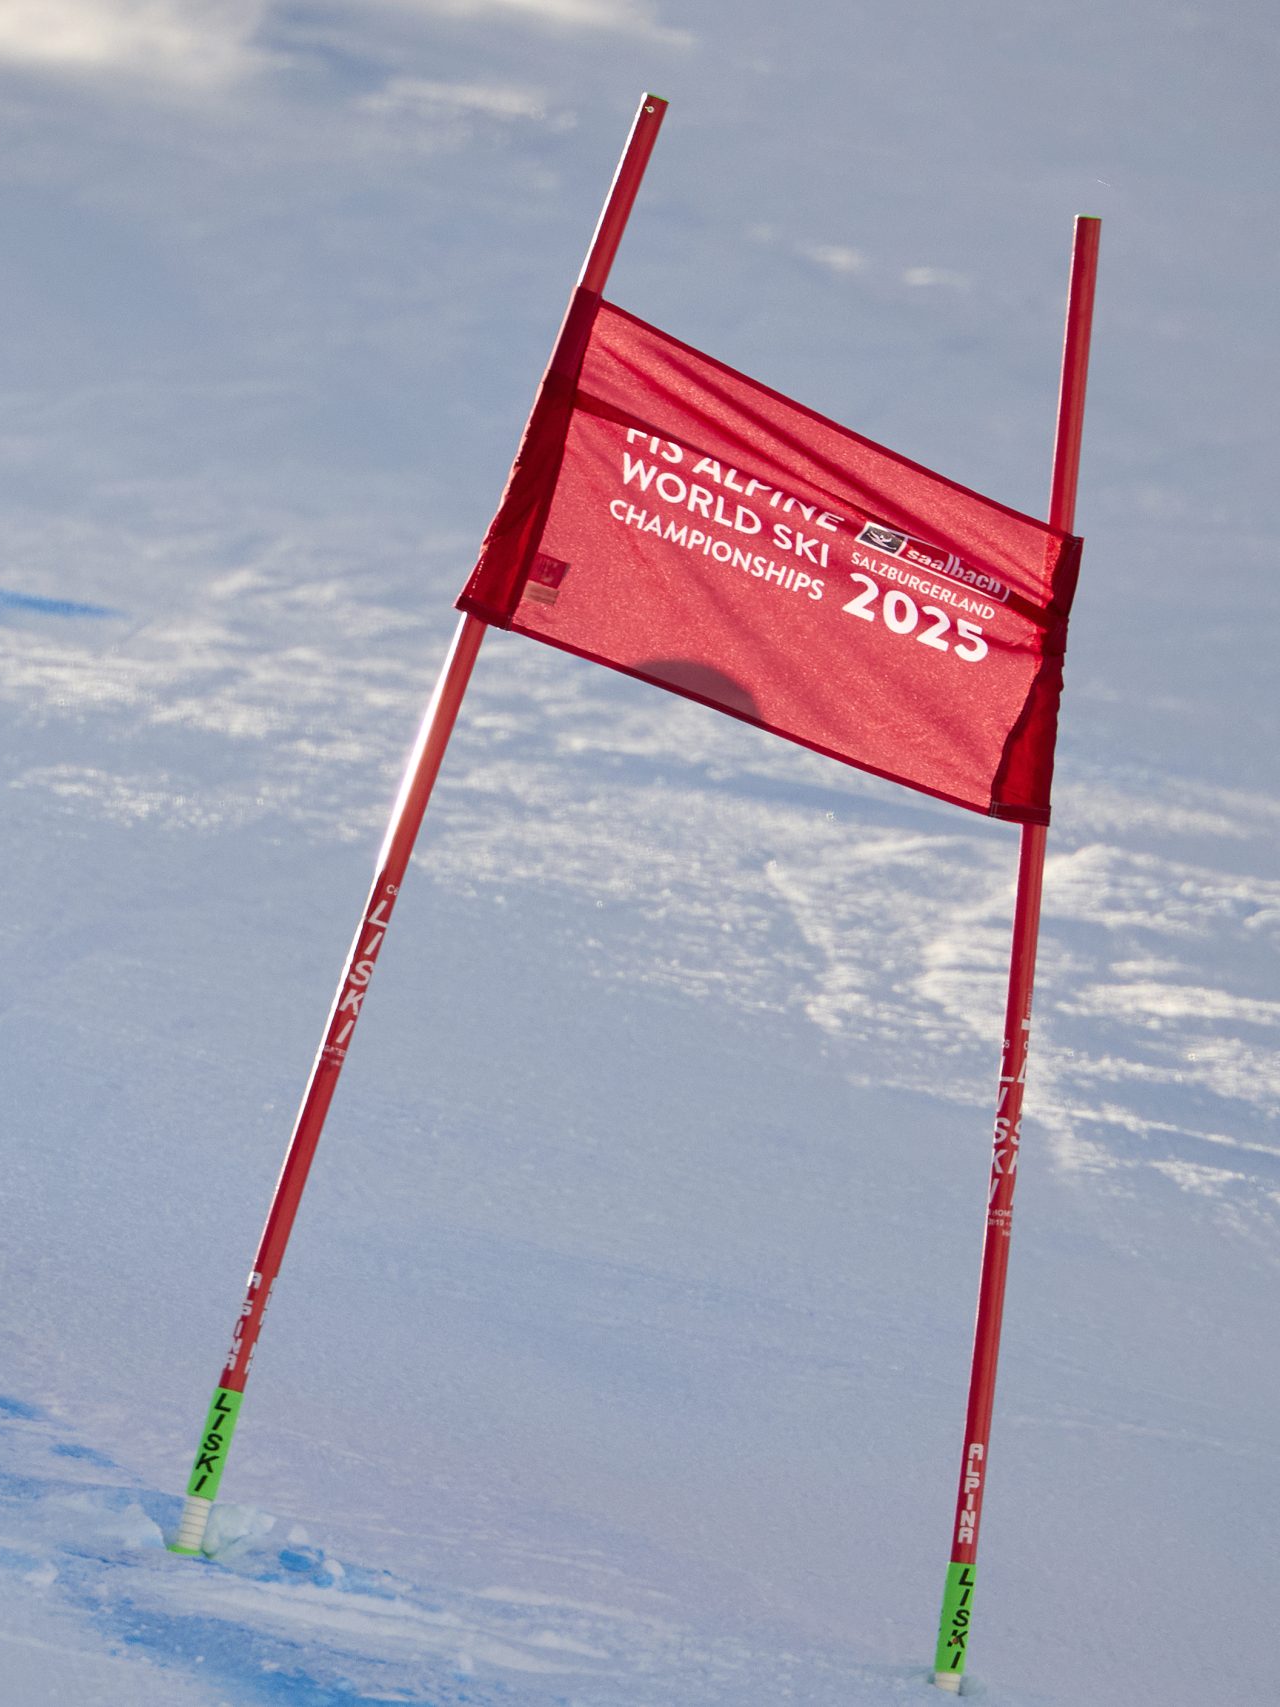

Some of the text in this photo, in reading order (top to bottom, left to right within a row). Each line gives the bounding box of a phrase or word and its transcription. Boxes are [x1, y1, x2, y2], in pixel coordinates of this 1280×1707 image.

[609, 499, 826, 601] CHAMPIONSHIPS
[623, 452, 830, 568] WORLD SKI
[842, 572, 989, 663] 2025
[851, 552, 996, 620] SALZBURGERLAND
[336, 899, 390, 1044] LISKI
[194, 1392, 232, 1492] LISKI
[957, 1443, 984, 1545] ALPINA
[946, 1567, 975, 1670] LISKI
